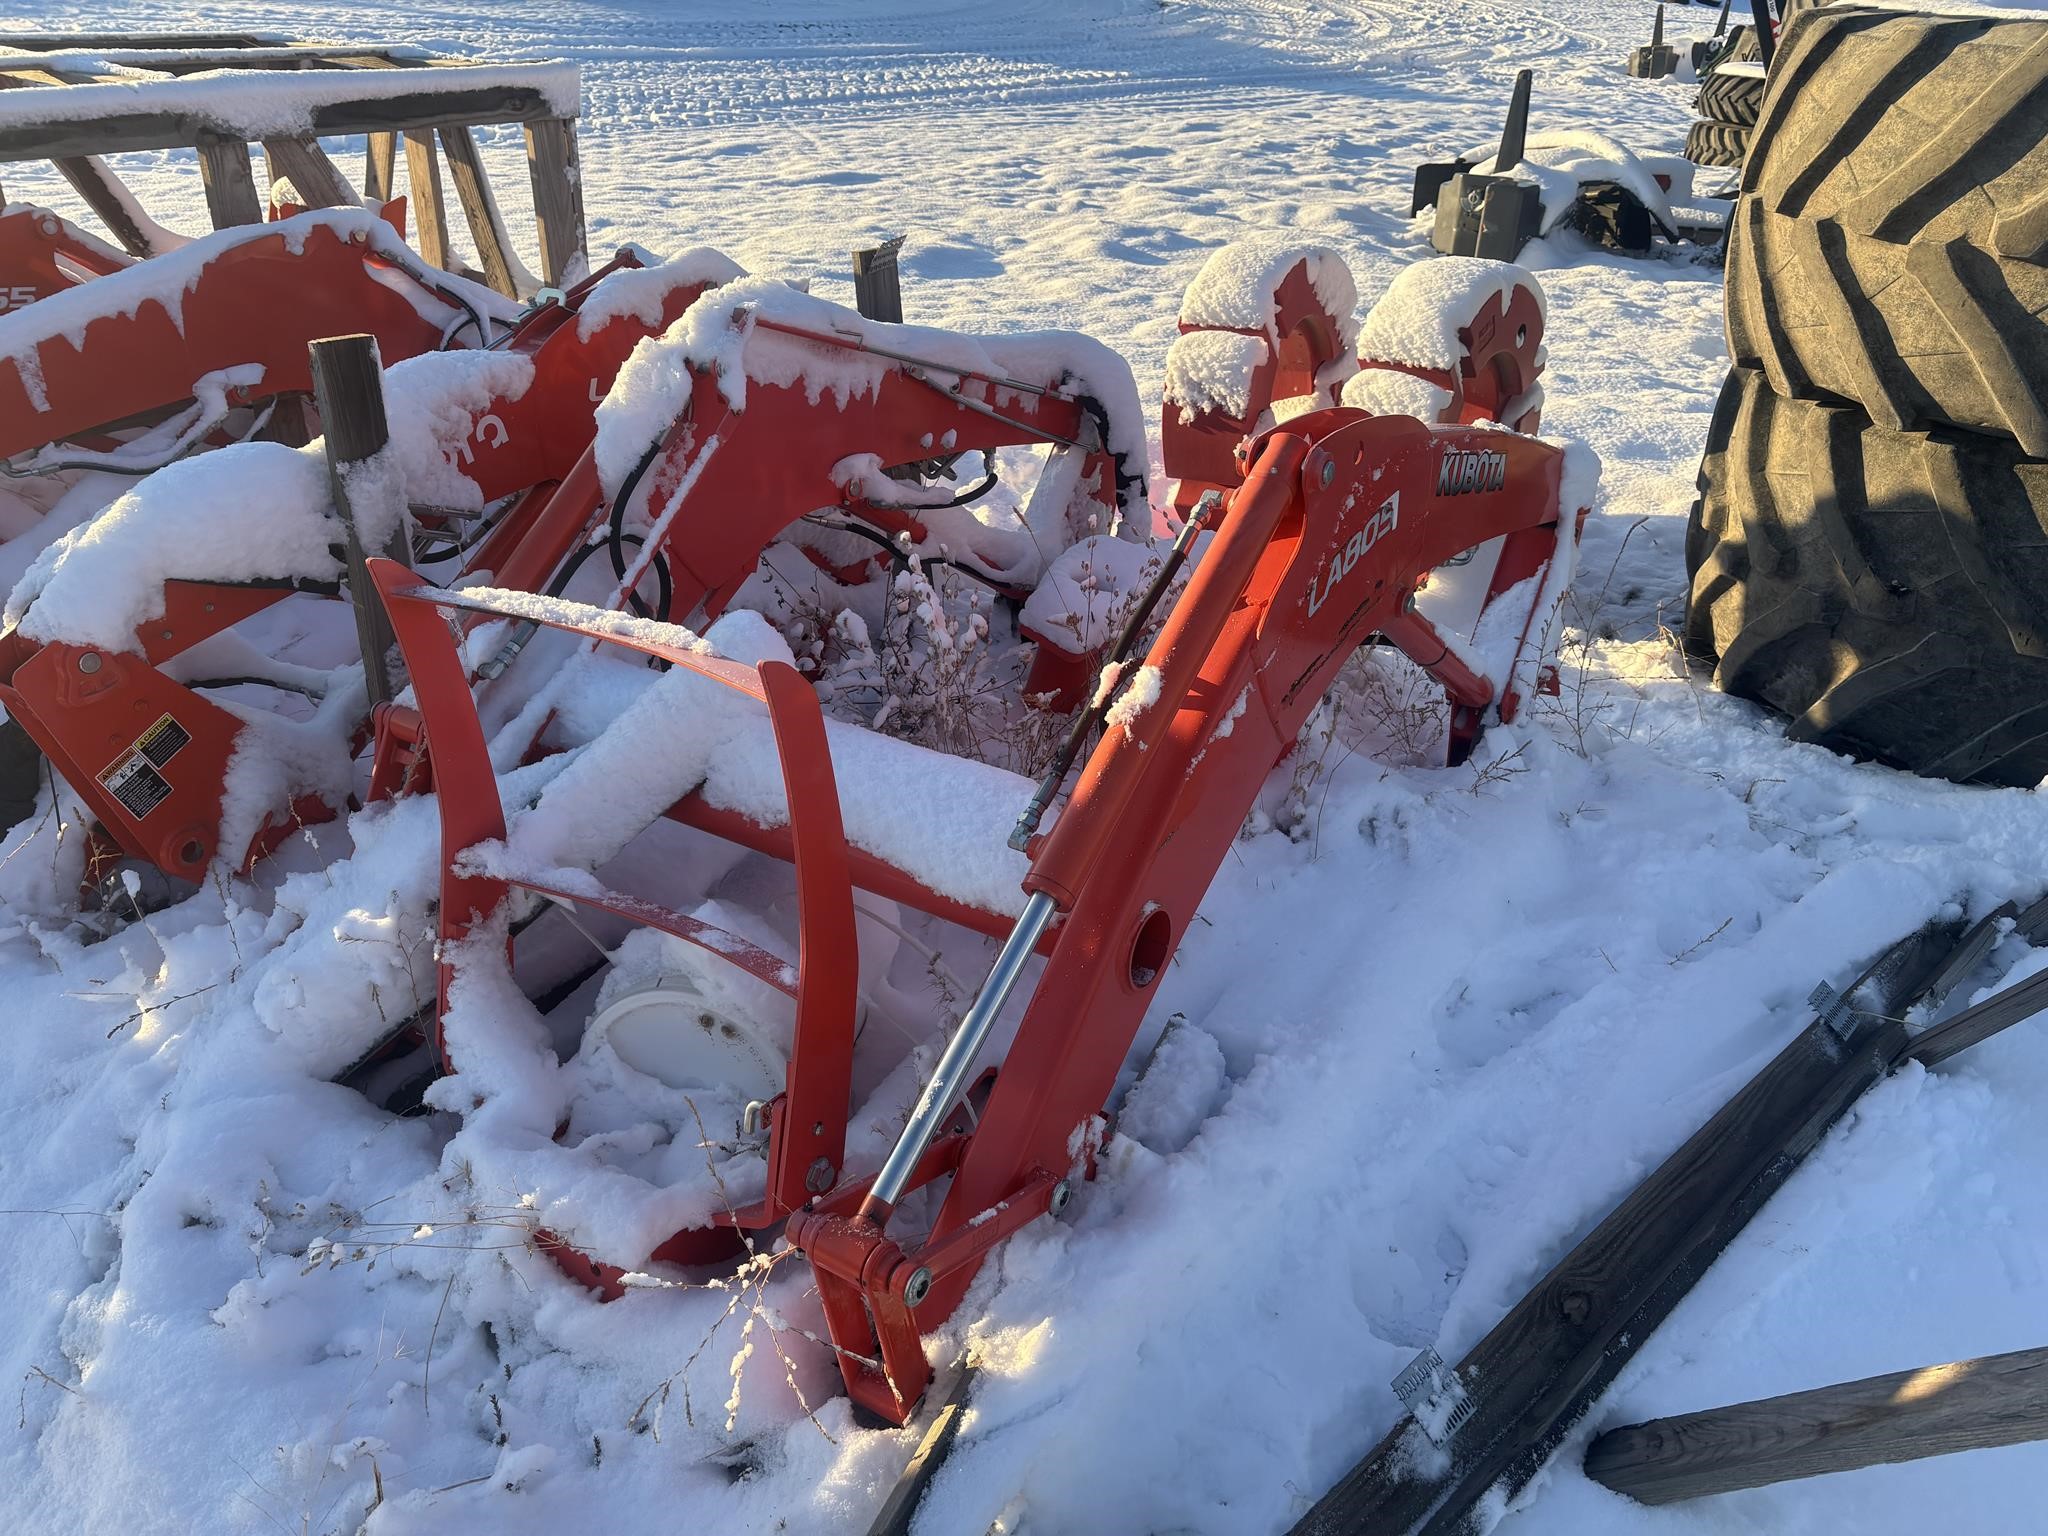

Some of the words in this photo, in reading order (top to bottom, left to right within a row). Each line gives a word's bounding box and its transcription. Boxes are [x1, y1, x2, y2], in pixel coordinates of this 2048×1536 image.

[1436, 452, 1507, 496] KUBOTA
[143, 716, 170, 742] CAUTION
[106, 751, 134, 777] WARNING
